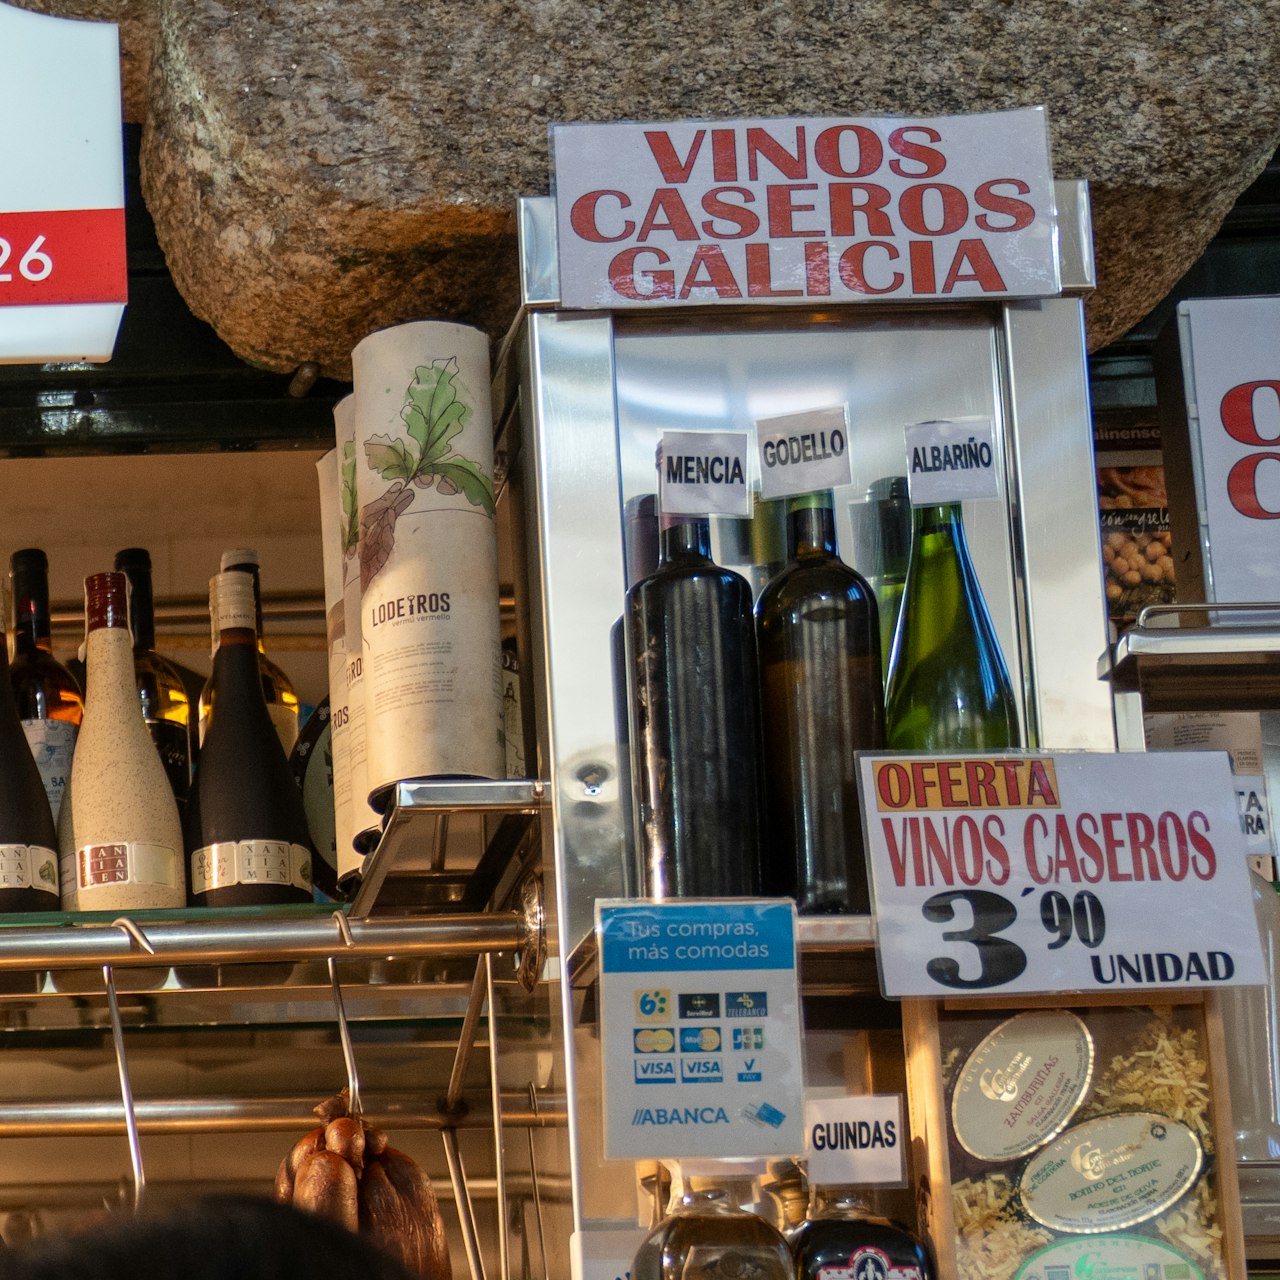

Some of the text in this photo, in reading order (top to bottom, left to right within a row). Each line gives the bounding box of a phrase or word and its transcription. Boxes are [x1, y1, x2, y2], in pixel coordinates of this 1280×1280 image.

[643, 125, 947, 184] VINOS
[570, 179, 1036, 243] CASEROS
[607, 239, 1008, 300] GALICIA
[763, 430, 845, 468] GODELLO
[911, 437, 993, 474] ALBARIÑO
[666, 455, 745, 485] MENCIA
[372, 592, 451, 628] LODEIROS
[392, 613, 451, 628] vermú vermello
[877, 760, 1058, 808] OFERTA
[881, 811, 1218, 887] VINOS CASEROS
[628, 921, 759, 940] Tus compras,
[629, 943, 769, 960] más comodas
[1090, 951, 1236, 985] UNIDAD
[727, 1008, 767, 1018] TELEBANCO
[641, 1062, 721, 1075] VISA VISA
[812, 1120, 896, 1151] GUINDAS
